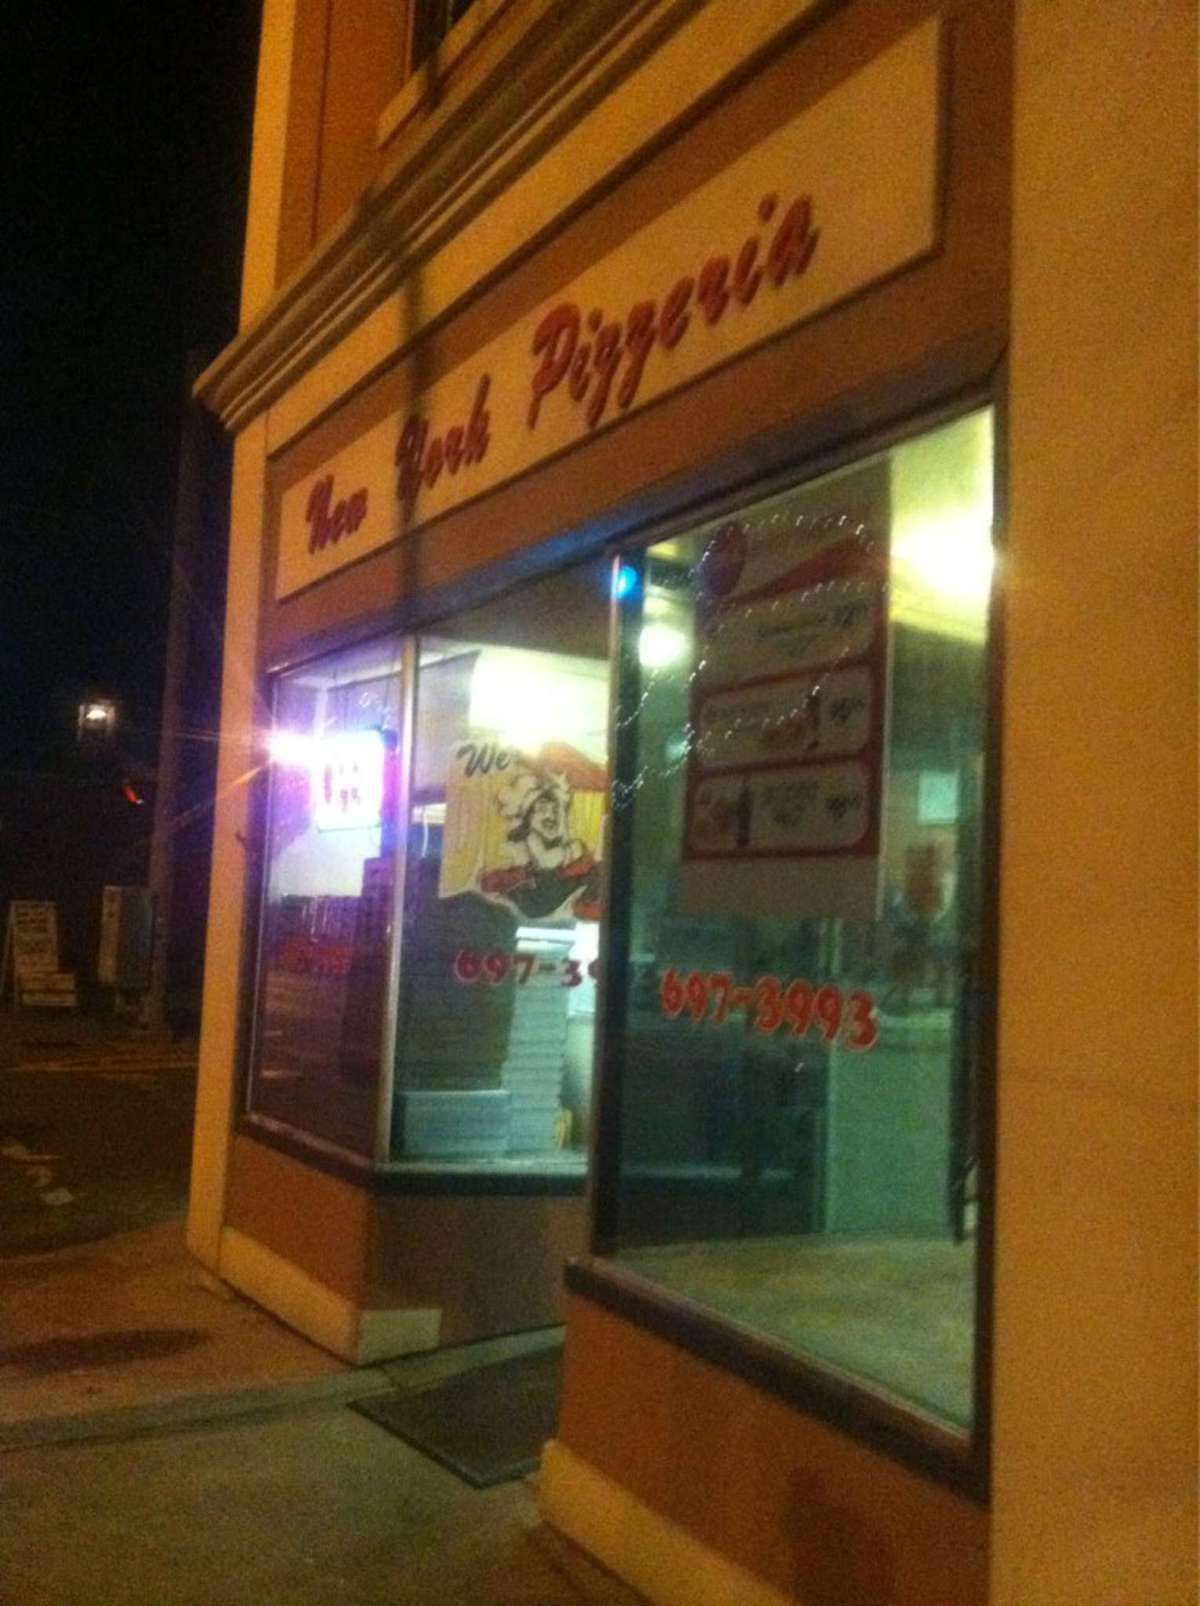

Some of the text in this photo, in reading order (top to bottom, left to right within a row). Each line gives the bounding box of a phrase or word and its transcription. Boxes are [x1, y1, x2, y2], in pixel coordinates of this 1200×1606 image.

[394, 374, 492, 522] York
[526, 192, 821, 431] Pizzeria
[456, 743, 510, 777] We
[659, 968, 880, 1051] 697-3993
